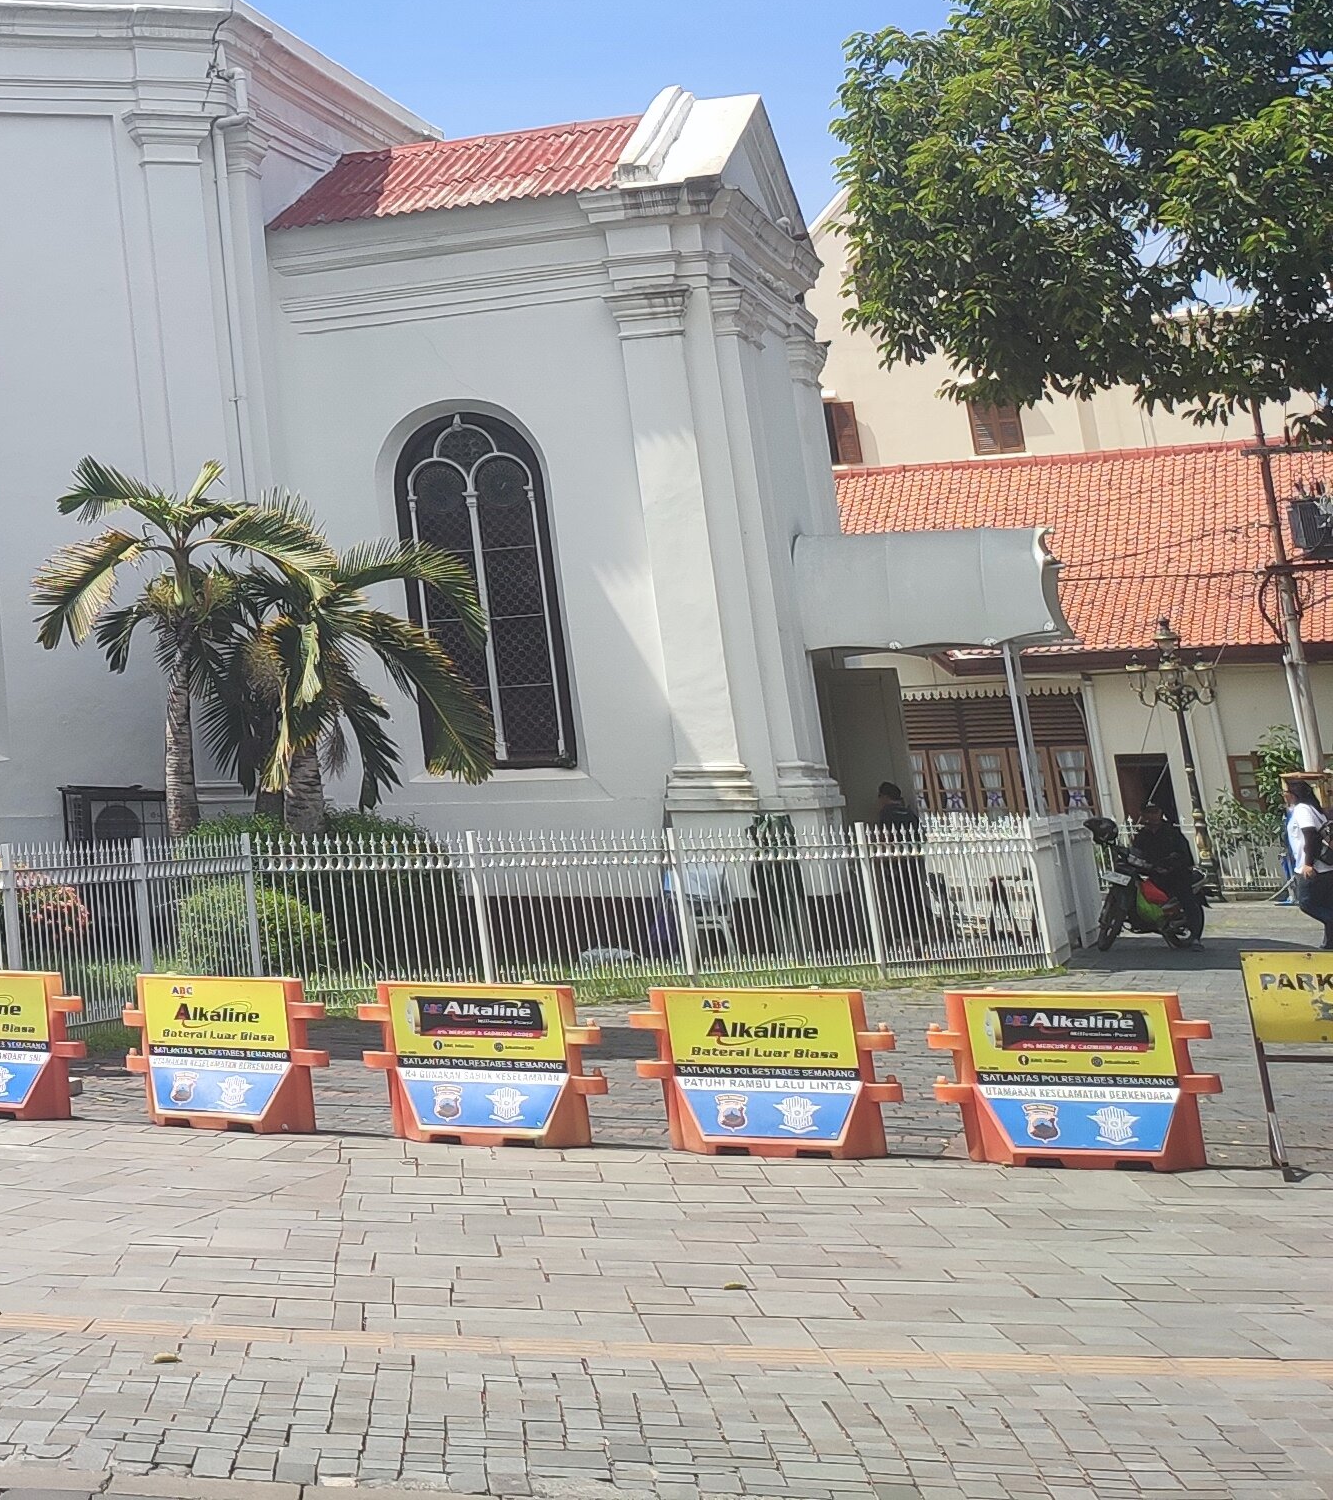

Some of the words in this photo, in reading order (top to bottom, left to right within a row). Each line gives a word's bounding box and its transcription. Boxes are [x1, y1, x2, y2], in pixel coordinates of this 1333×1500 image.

[1259, 973, 1333, 991] PARK
[443, 1001, 531, 1017] Alkaline
[702, 1000, 730, 1009] ABC
[174, 1003, 260, 1023] Alkaline
[1030, 1013, 1134, 1028] Alkaline
[706, 1018, 818, 1039] Alkaline
[210, 1031, 237, 1040] Luar
[240, 1032, 274, 1041] Biasa
[754, 1048, 790, 1058] Luar
[794, 1049, 838, 1058] Biasa
[403, 1057, 451, 1065] SATLANTAS
[453, 1059, 512, 1067] POLRESTABES
[514, 1061, 563, 1069] SEMARANG
[680, 1066, 731, 1074] SATLANTAS
[733, 1068, 800, 1076] POLRESTABES
[684, 1078, 725, 1087] PATUHI
[730, 1080, 770, 1088] RAMBU
[776, 1081, 805, 1089] LALU
[810, 1082, 851, 1090] LINTAS
[982, 1074, 1039, 1082] SATLANTAS
[1041, 1075, 1113, 1084] POLRESTABES
[1116, 1077, 1174, 1085] SEMARANG
[986, 1087, 1035, 1097] UTAMAKAN
[1039, 1089, 1106, 1098] KESELAMATAN
[1109, 1090, 1173, 1100] BERKENDARA
